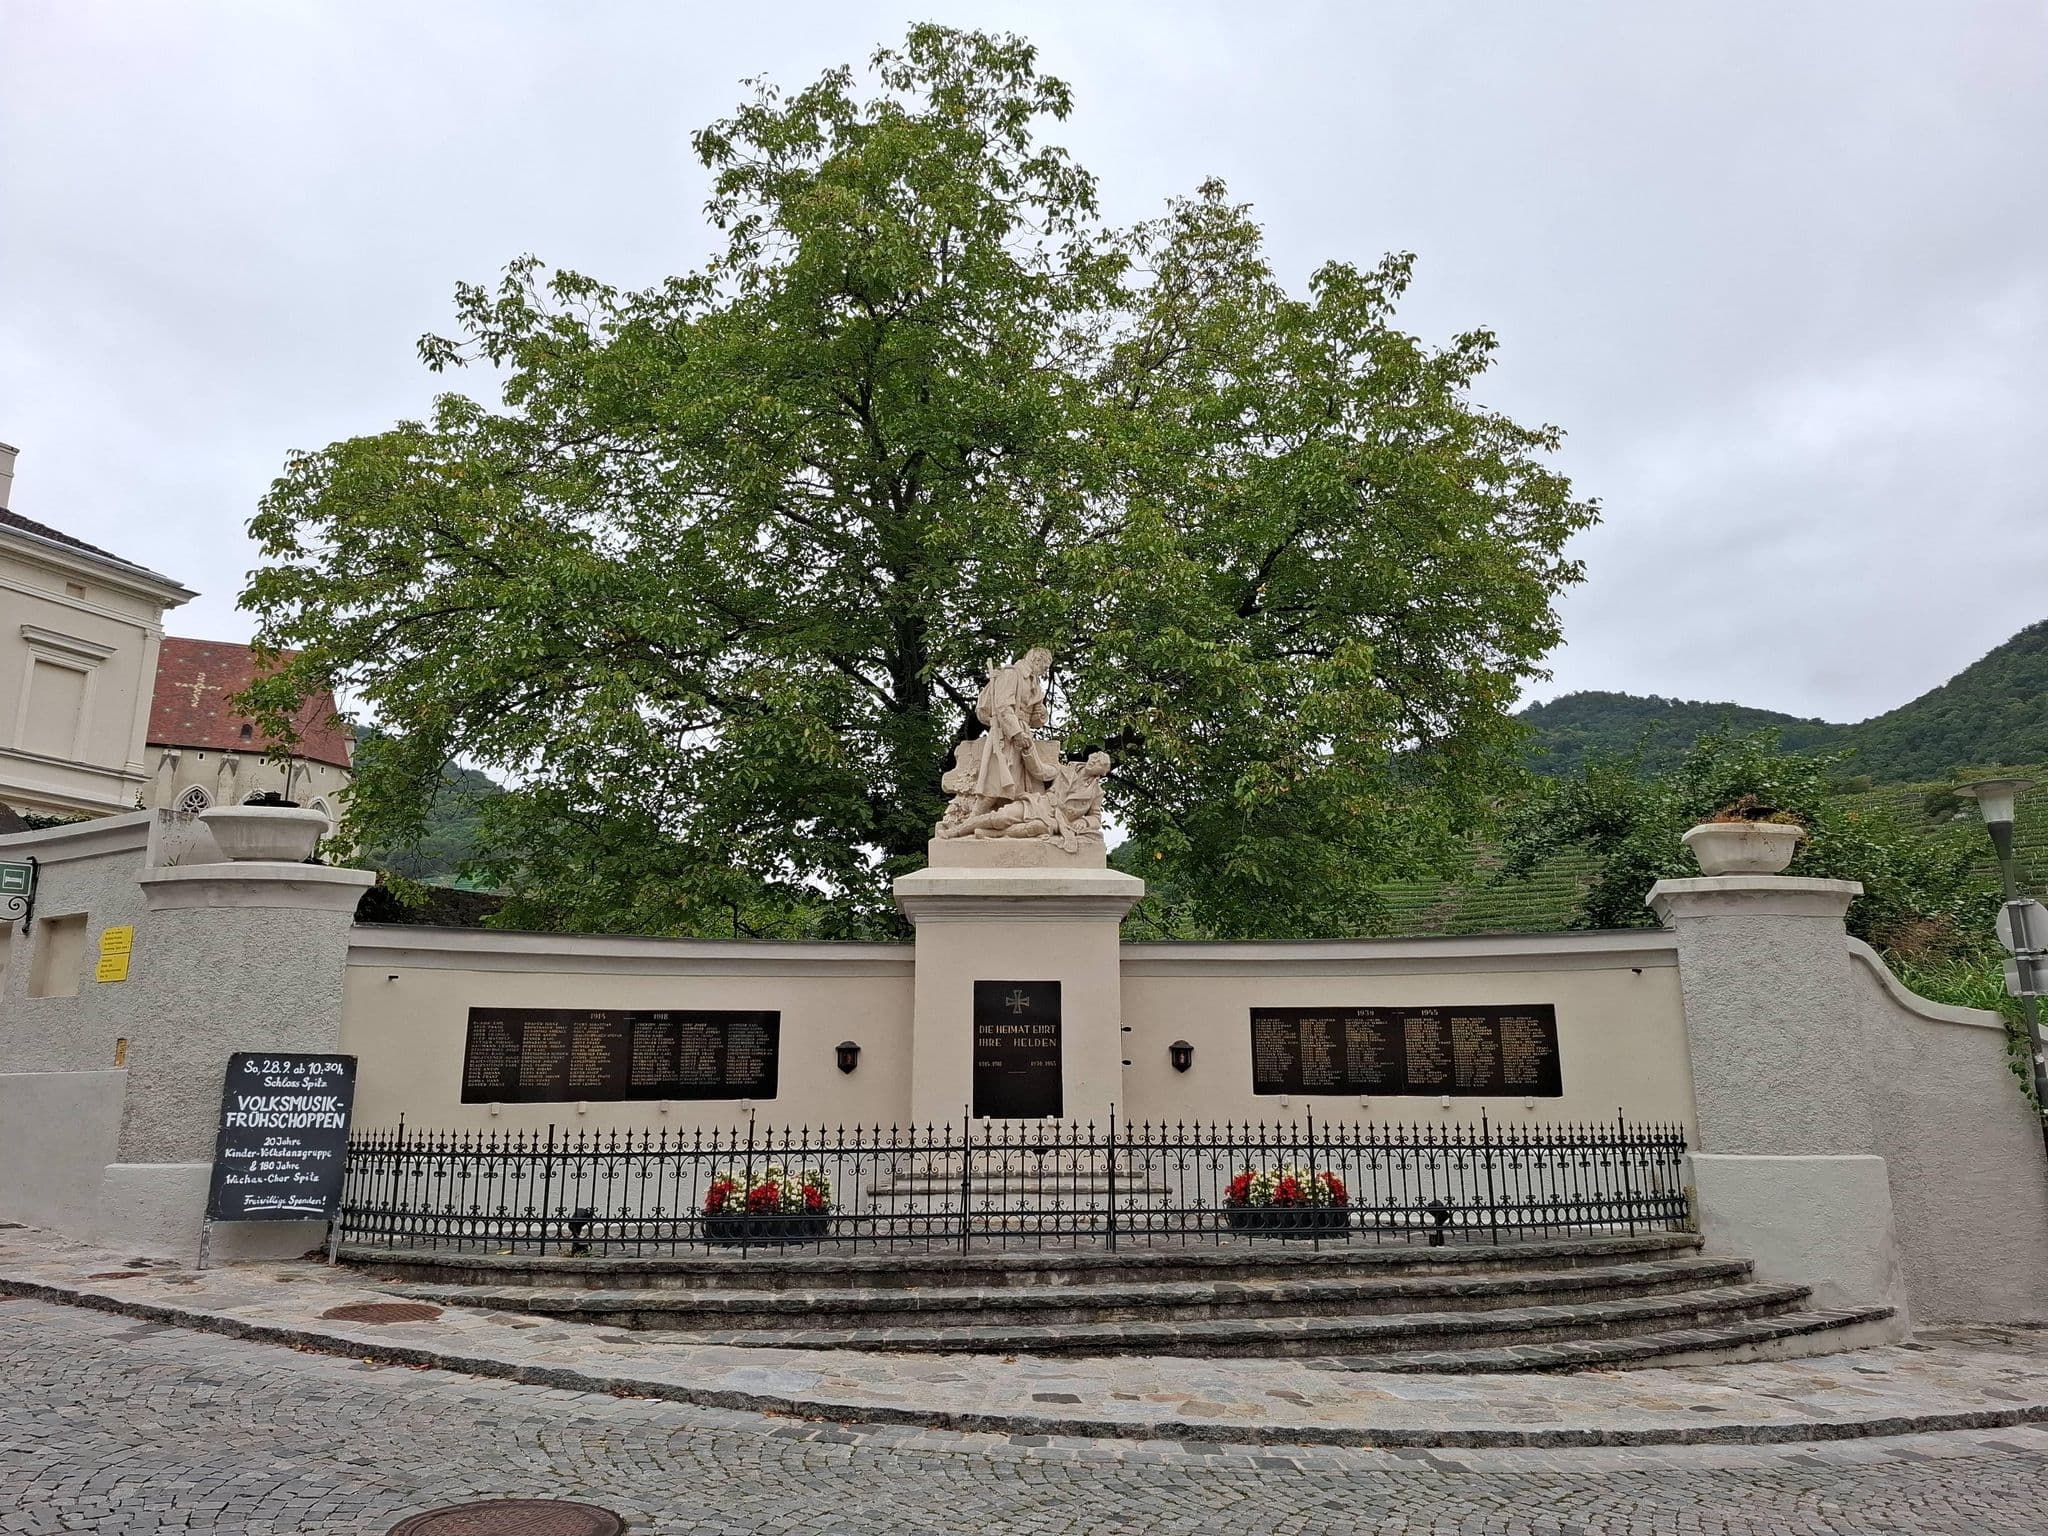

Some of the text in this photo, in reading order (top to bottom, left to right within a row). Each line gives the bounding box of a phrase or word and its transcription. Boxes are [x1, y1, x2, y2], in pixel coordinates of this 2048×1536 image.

[979, 1024, 1056, 1034] DIE HEIMAT EHRT
[978, 1038, 1057, 1047] IHRE HELDEN
[293, 1063, 306, 1074] ab
[263, 1076, 328, 1091] Schloss Spitz
[238, 1095, 344, 1112] VOLKSMUSIK-
[226, 1111, 346, 1129] FRÜHSCHOPPEN
[263, 1137, 302, 1146] 20 Jahre
[224, 1147, 333, 1160] Kinder-Volkstanzgruppe
[249, 1160, 300, 1172] & 180 Jahre
[293, 1172, 320, 1184] Spitz
[288, 1195, 326, 1206] Spenden!
